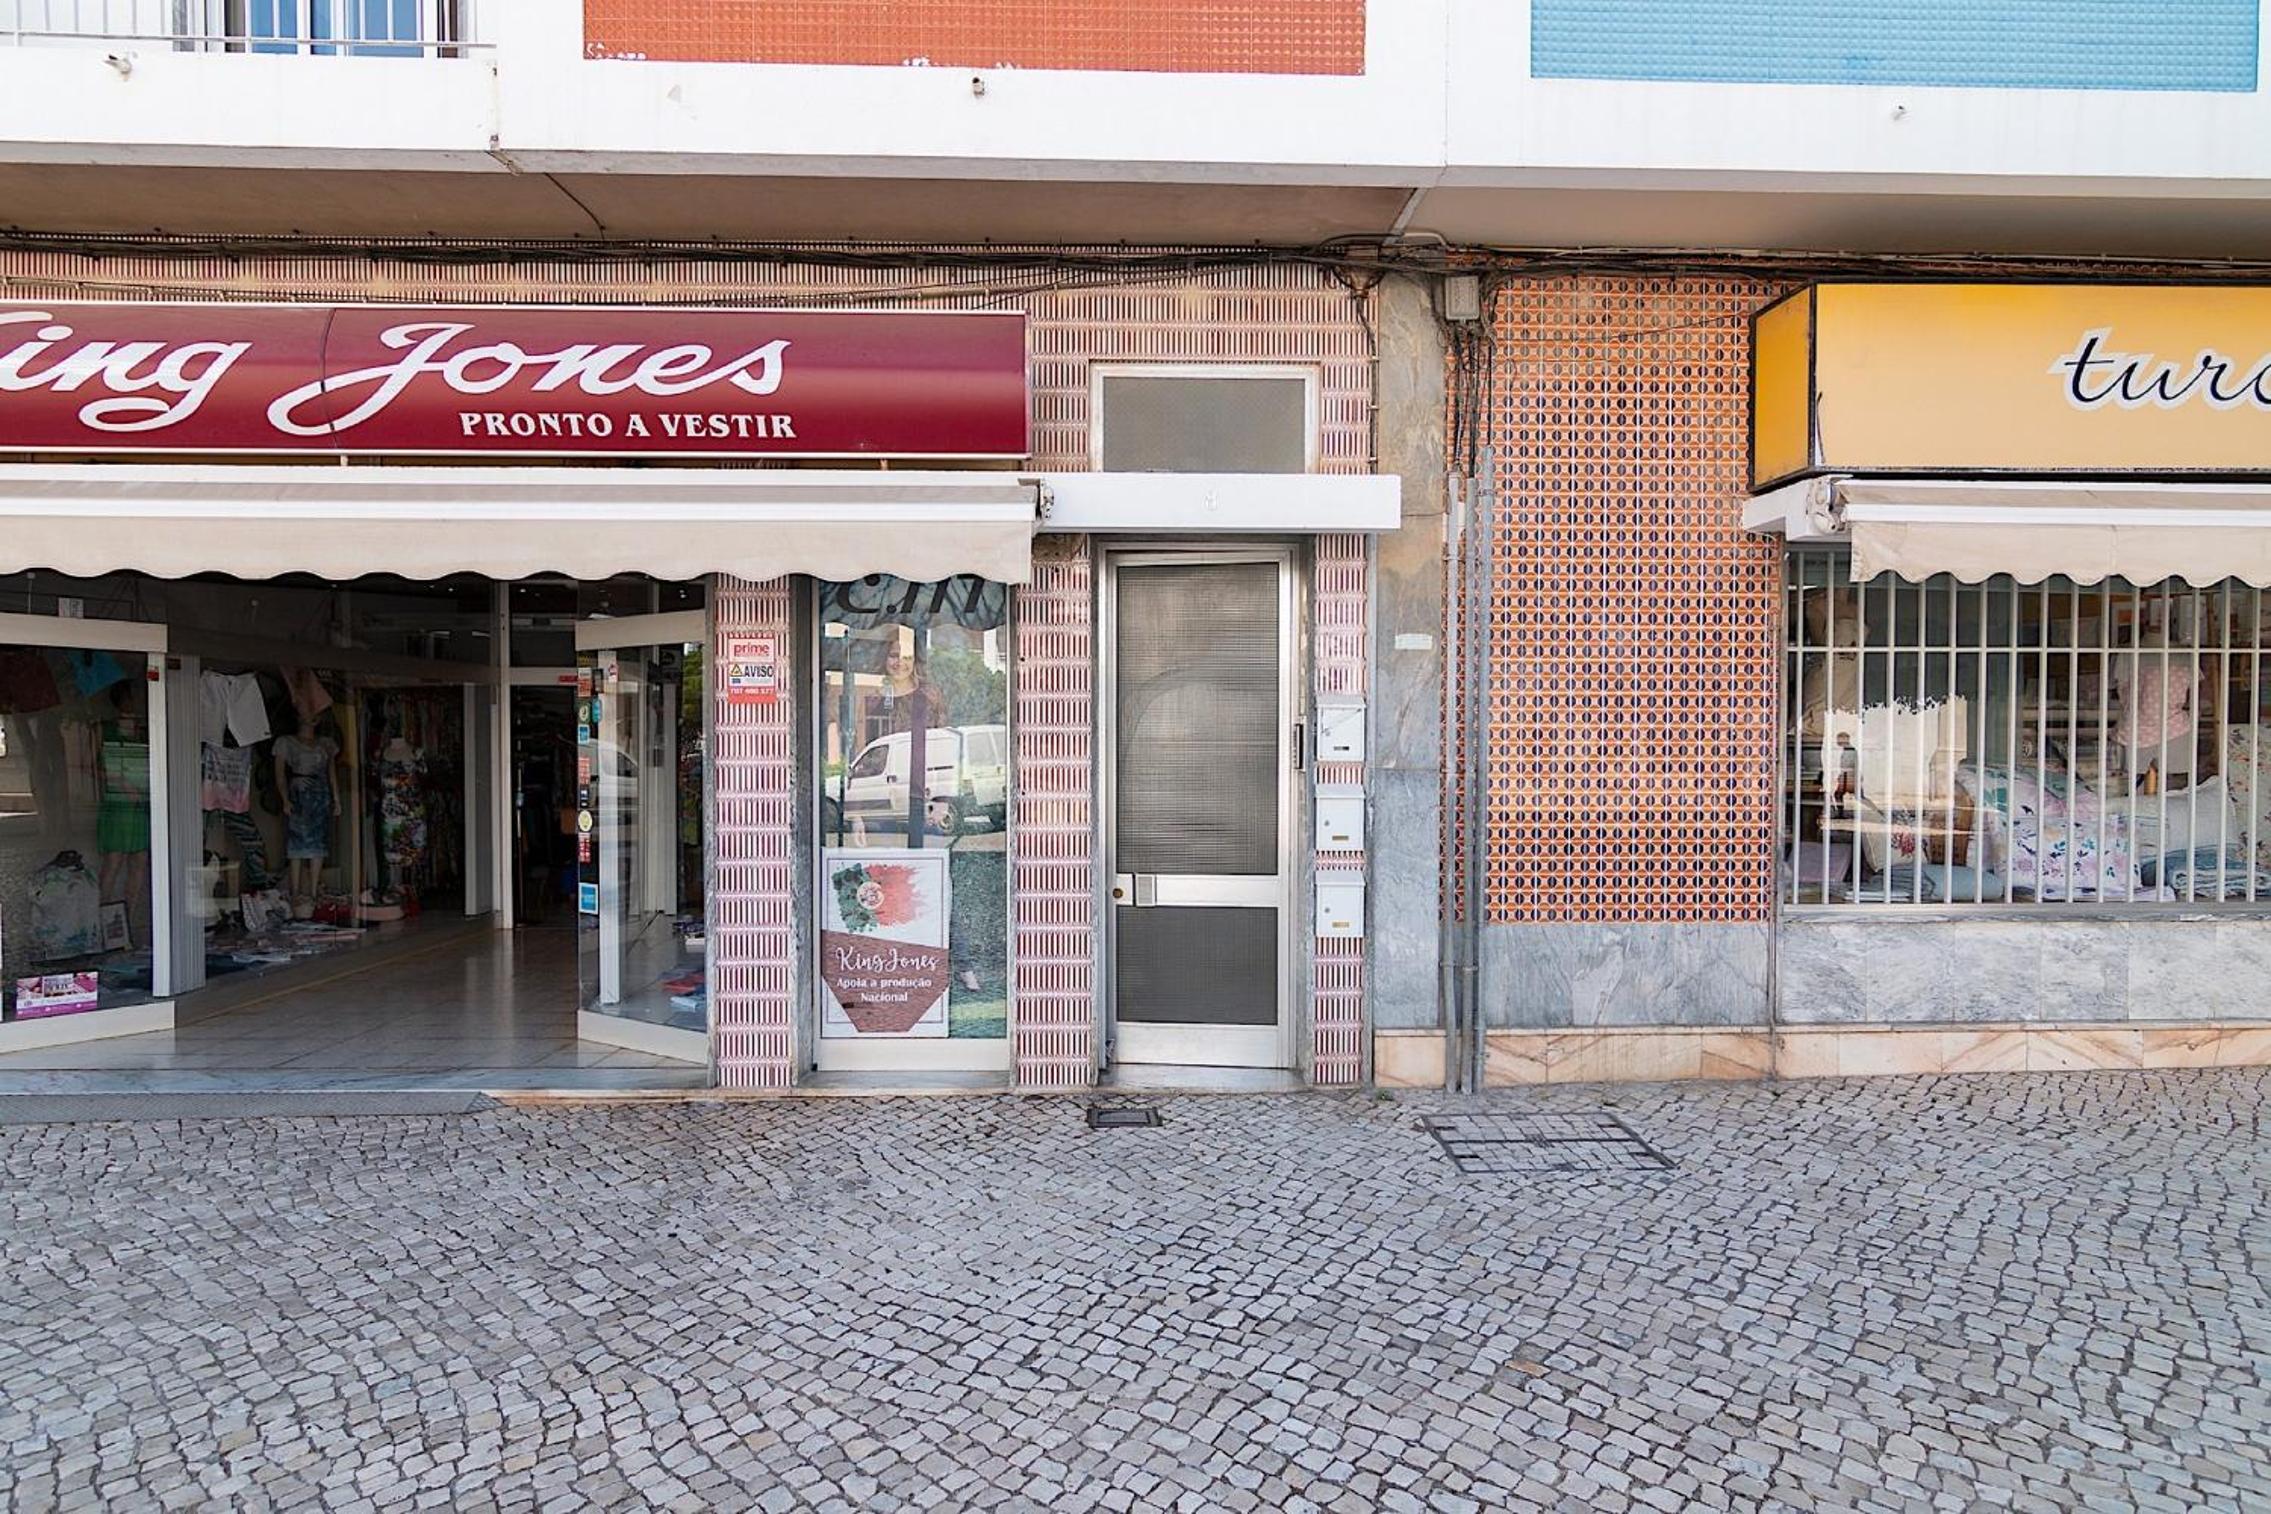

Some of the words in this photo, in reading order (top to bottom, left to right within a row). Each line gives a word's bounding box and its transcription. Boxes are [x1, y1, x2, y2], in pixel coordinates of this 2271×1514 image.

[0, 311, 253, 432] ing
[266, 323, 792, 436] Jones
[459, 412, 613, 437] PRONTO
[625, 413, 649, 437] A
[658, 414, 797, 439] VESTIR
[733, 642, 770, 657] prime
[836, 976, 867, 989] Apoia
[869, 979, 877, 988] a
[880, 976, 932, 989] produção
[860, 991, 908, 1002] Nacional
